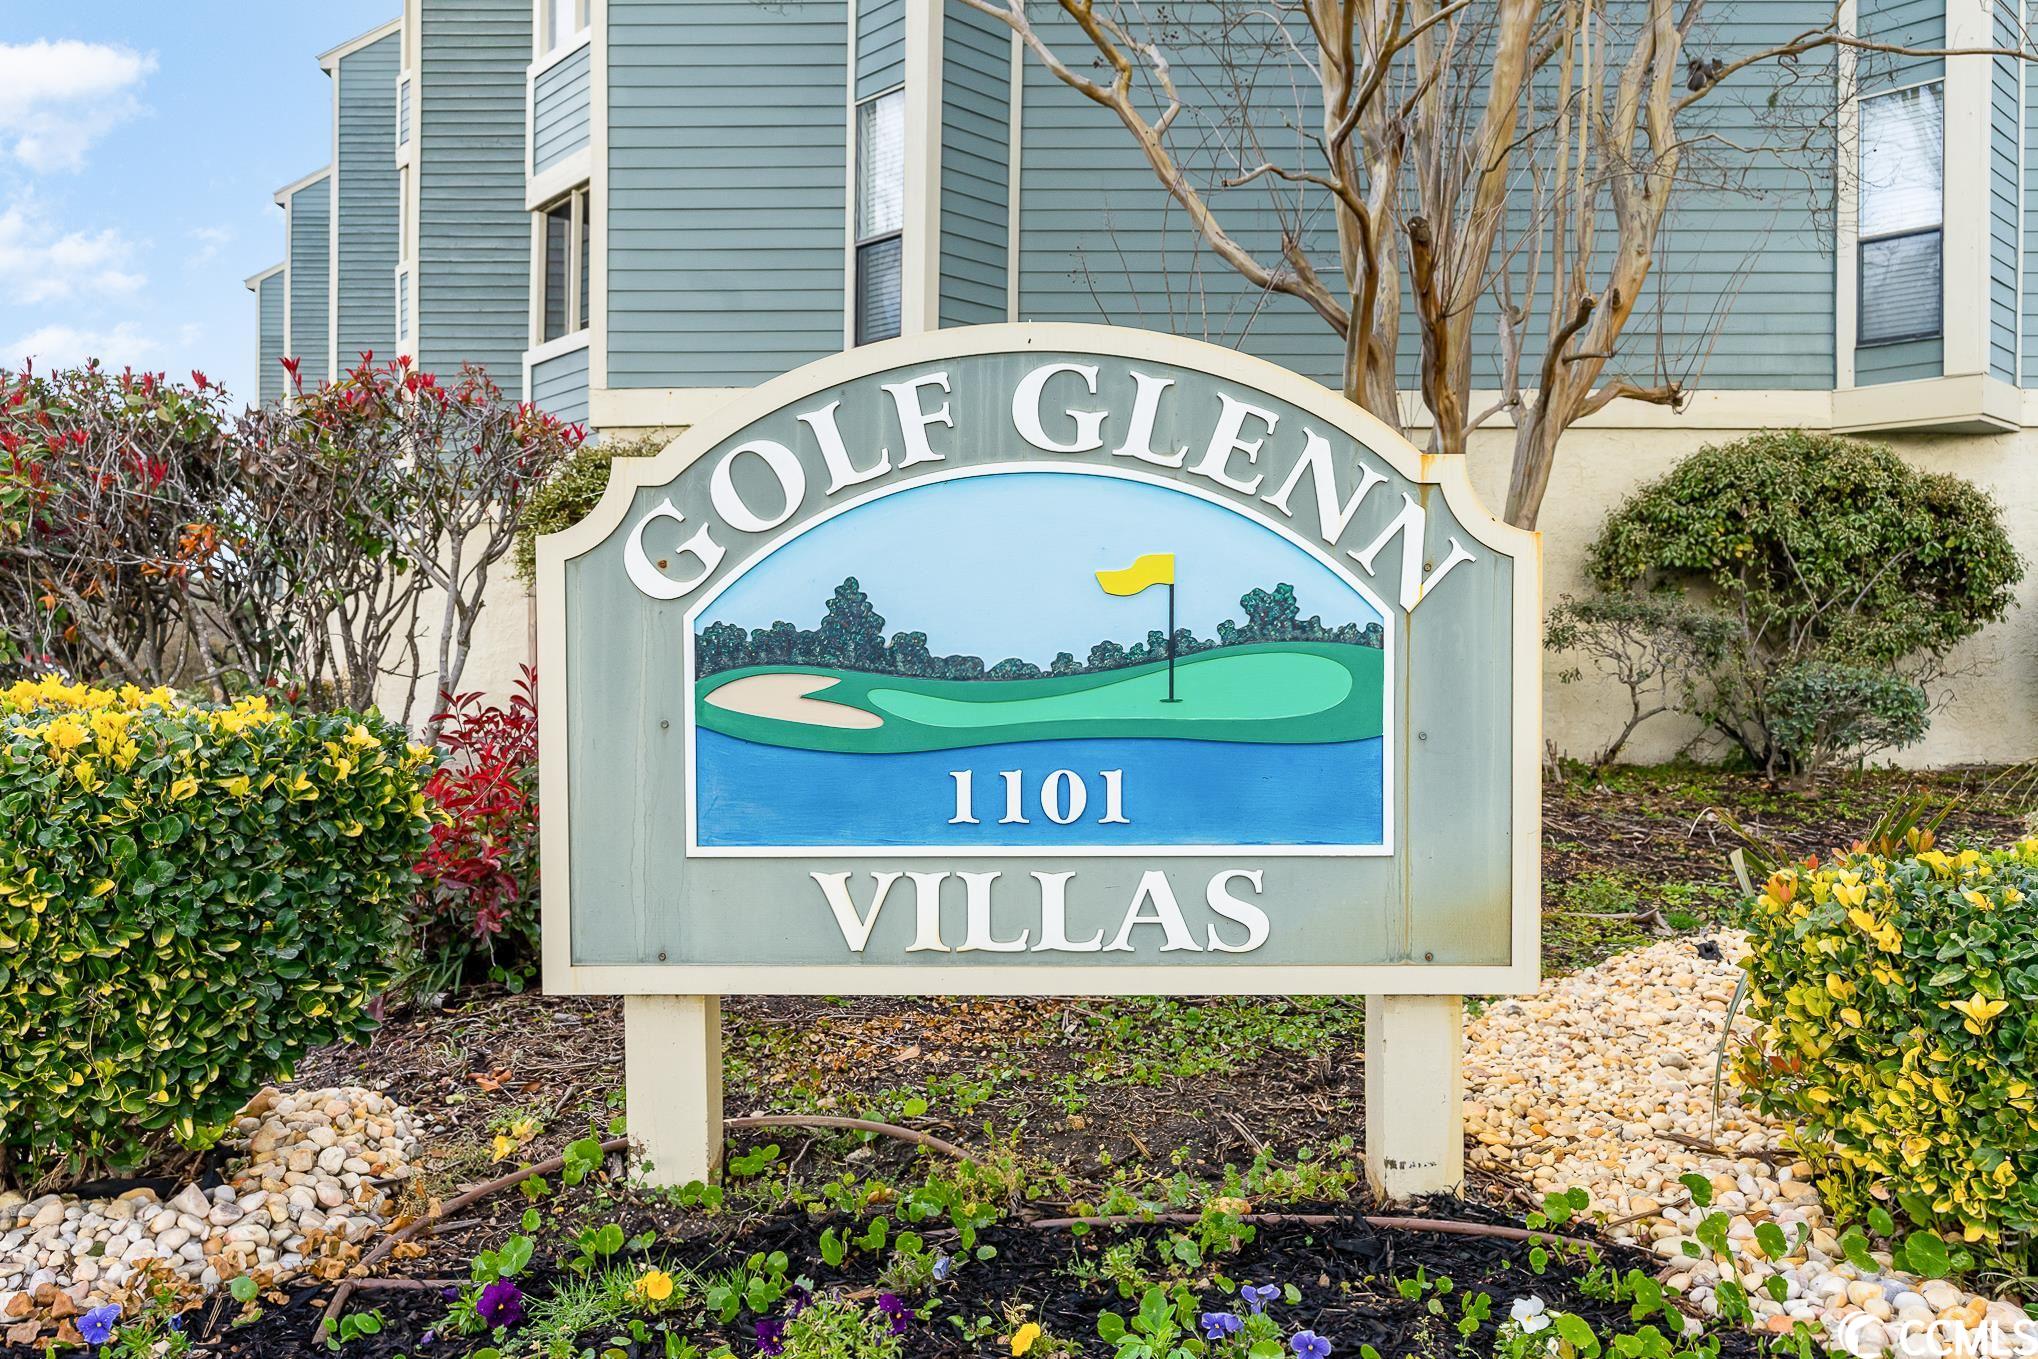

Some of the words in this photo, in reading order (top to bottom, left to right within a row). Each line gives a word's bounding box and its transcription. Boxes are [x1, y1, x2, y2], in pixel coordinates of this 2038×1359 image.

[623, 371, 954, 600] GOLF
[1012, 363, 1476, 613] GLENN
[948, 769, 1130, 825] 1101
[809, 869, 1270, 953] VILLAS
